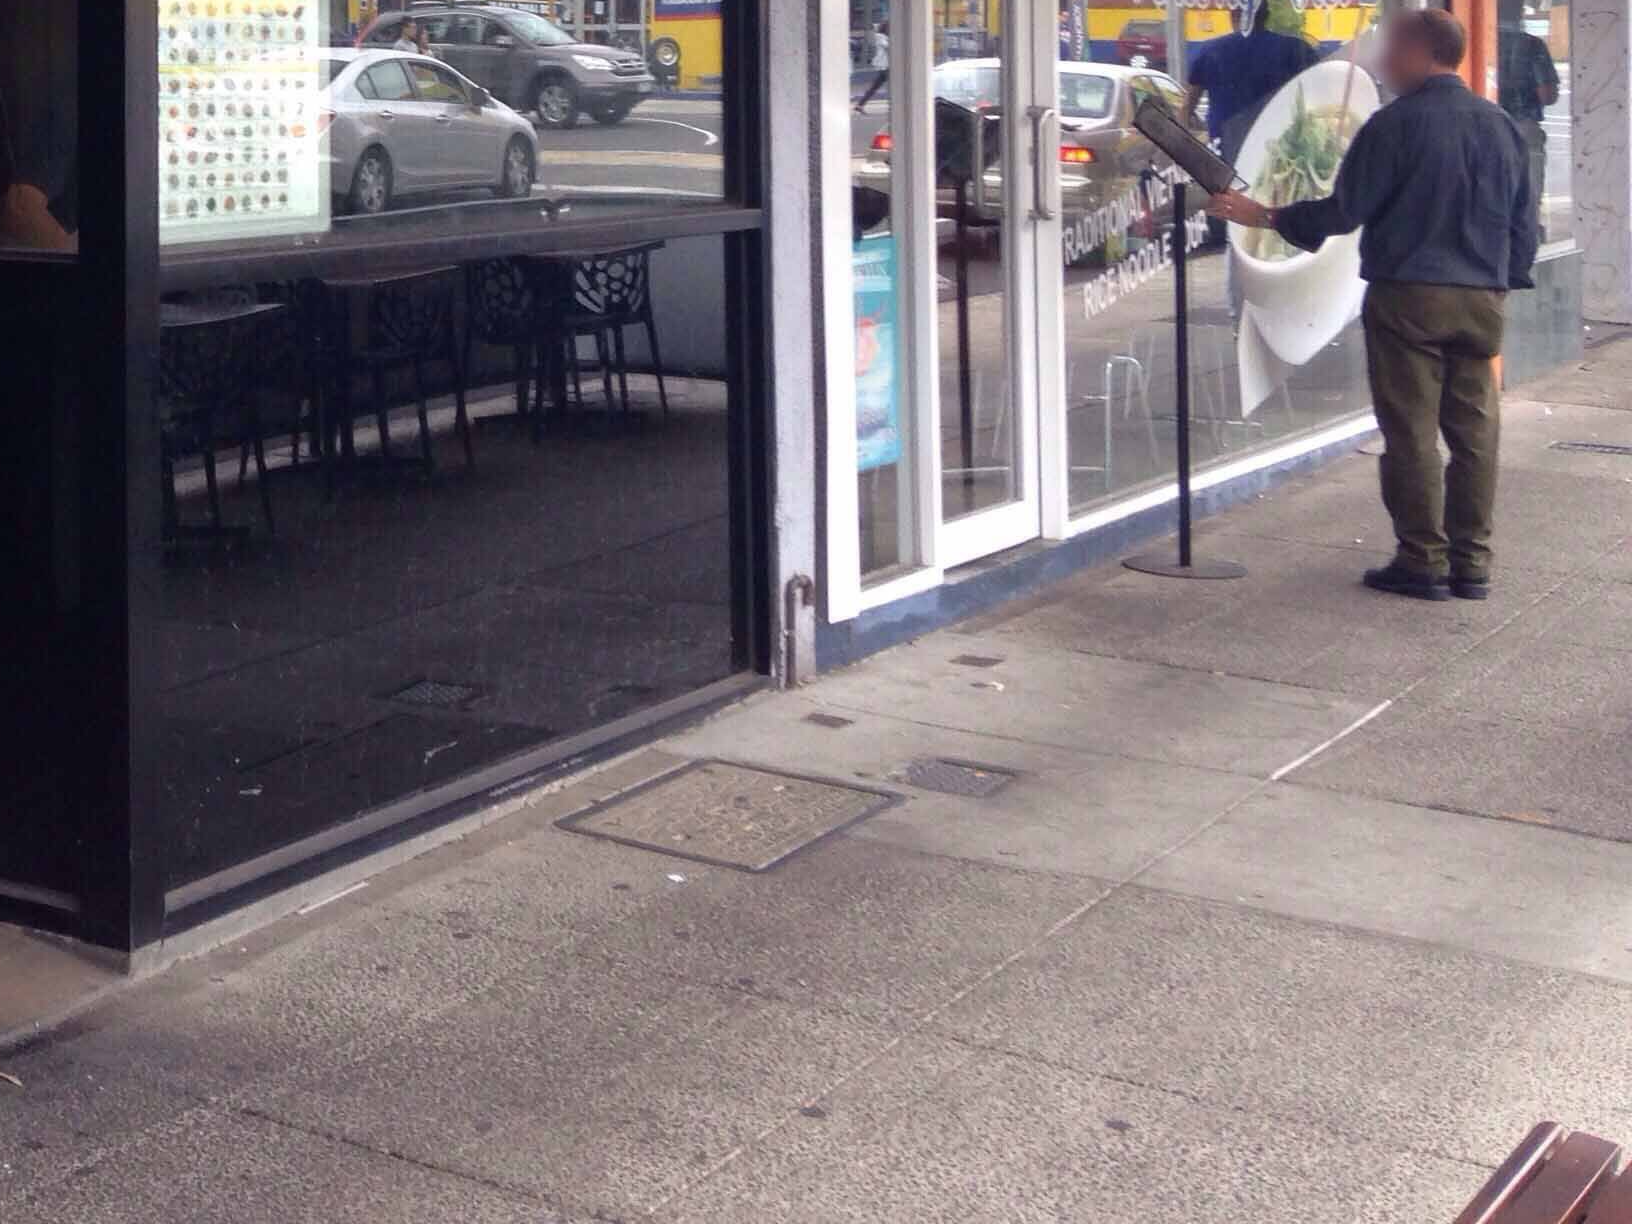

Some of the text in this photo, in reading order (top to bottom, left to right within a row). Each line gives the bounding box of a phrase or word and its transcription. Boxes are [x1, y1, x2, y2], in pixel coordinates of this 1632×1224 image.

[1063, 185, 1146, 266] RADITIONAL
[1083, 268, 1117, 319] RICE
[1119, 232, 1173, 297] NOODLE
